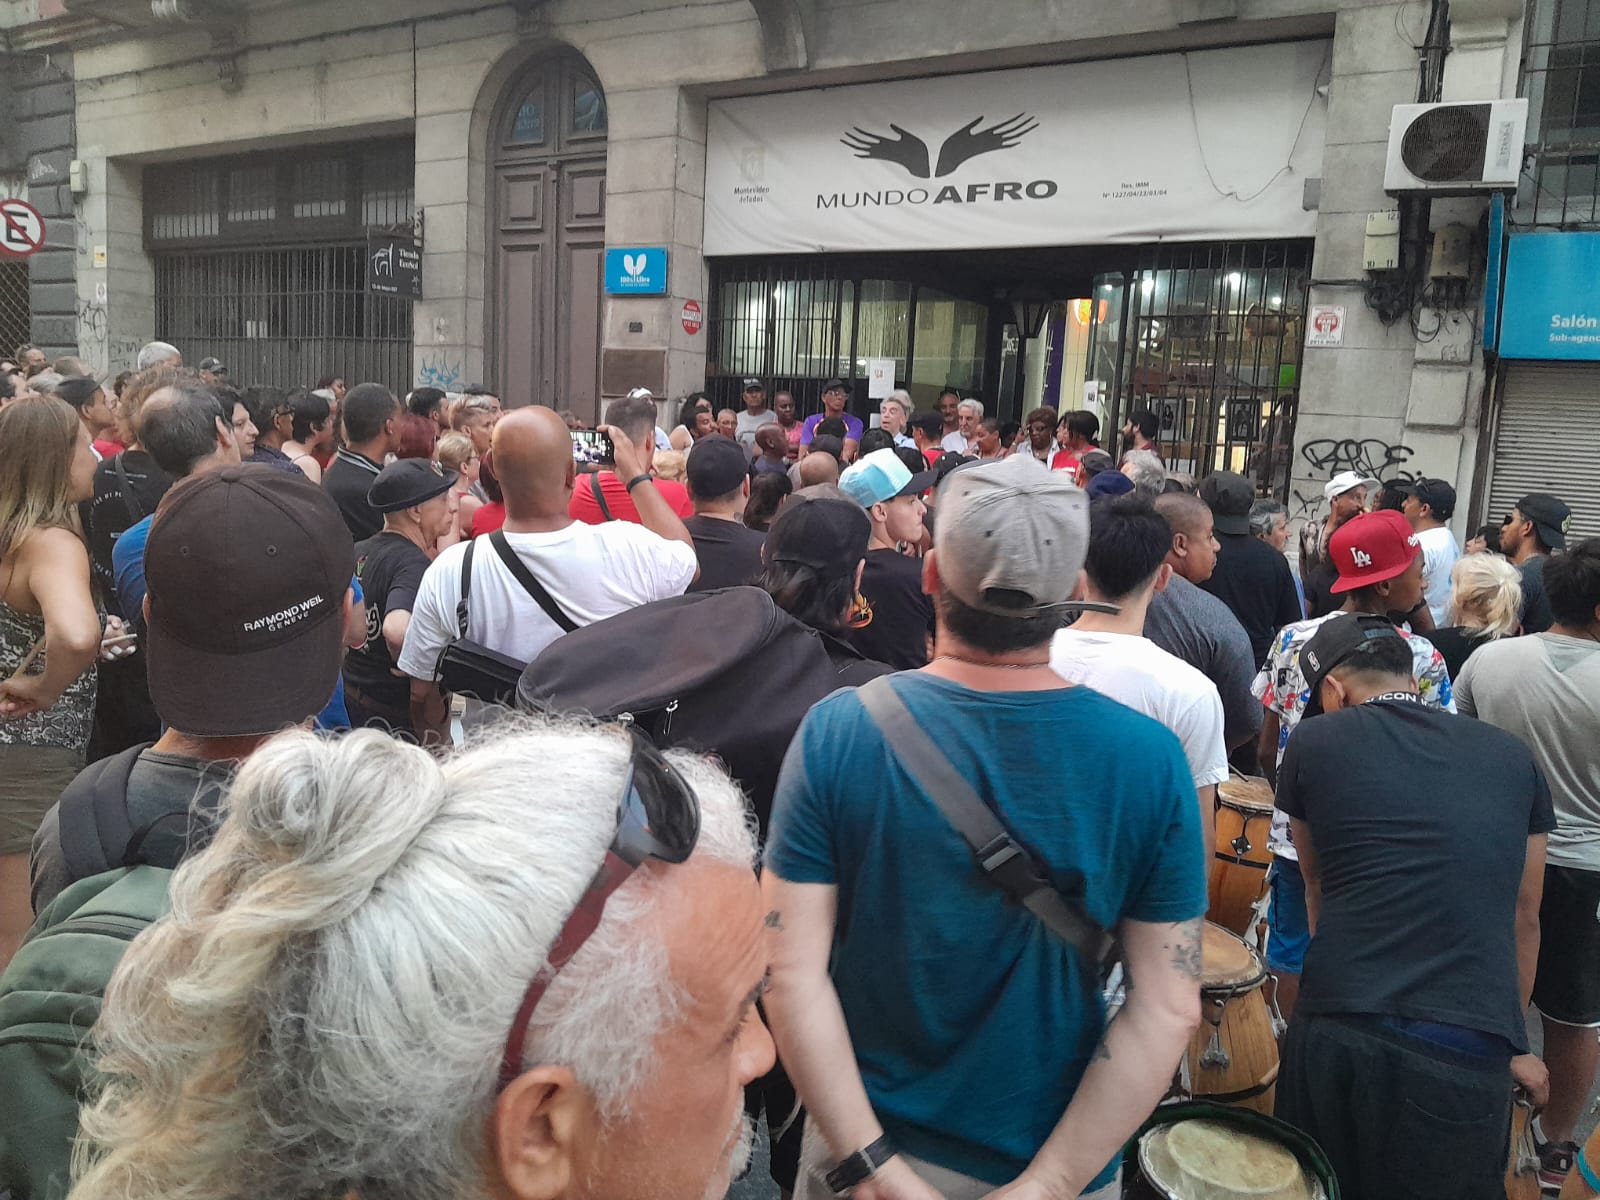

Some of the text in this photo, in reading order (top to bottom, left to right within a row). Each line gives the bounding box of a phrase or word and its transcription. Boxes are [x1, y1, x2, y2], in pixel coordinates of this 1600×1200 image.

[1551, 313, 1597, 328] Salón
[1350, 546, 1372, 568] LA
[243, 594, 324, 632] RAYMOND WEIL
[268, 610, 310, 632] GENEVE
